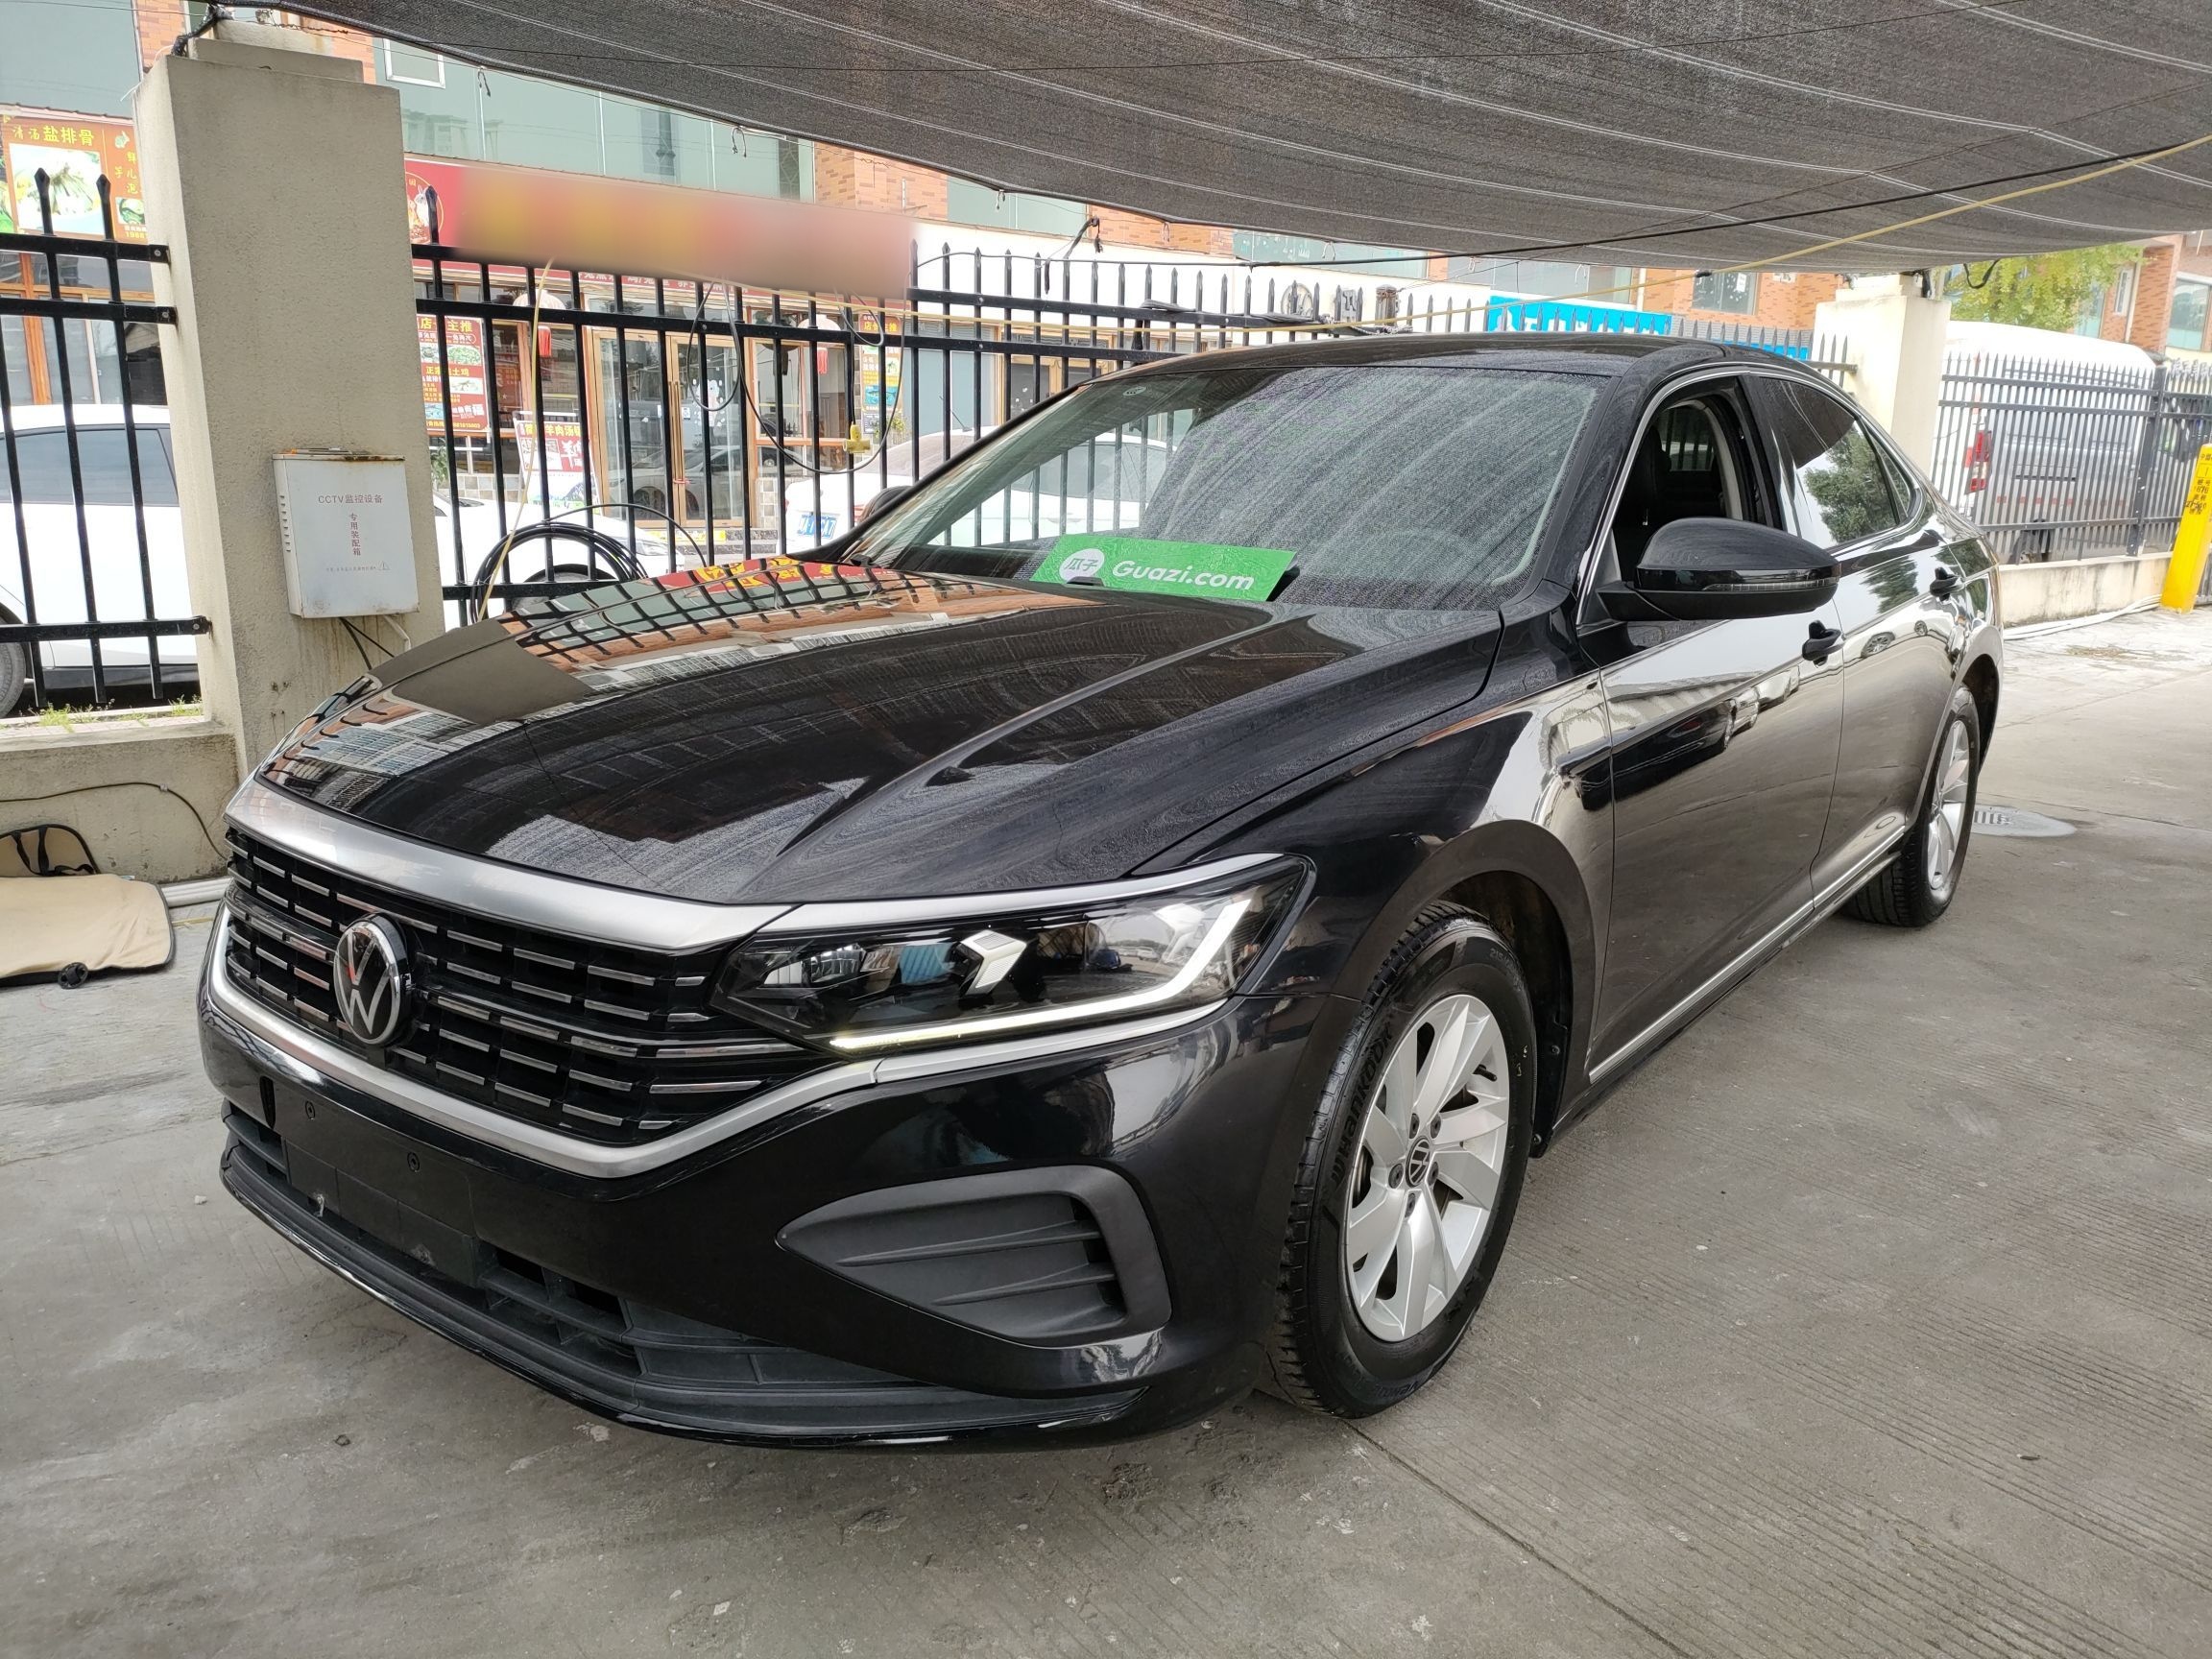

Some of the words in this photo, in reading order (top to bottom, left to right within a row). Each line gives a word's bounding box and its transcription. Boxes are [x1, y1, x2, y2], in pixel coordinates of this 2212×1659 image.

[421, 318, 472, 332] 店主推
[426, 366, 469, 376] 正宗土鸡
[318, 493, 383, 504] CCTV监控设备
[349, 512, 361, 556] 专用装配箱
[1064, 558, 1099, 572] 瓜子
[1112, 560, 1255, 590] Guazi.com
